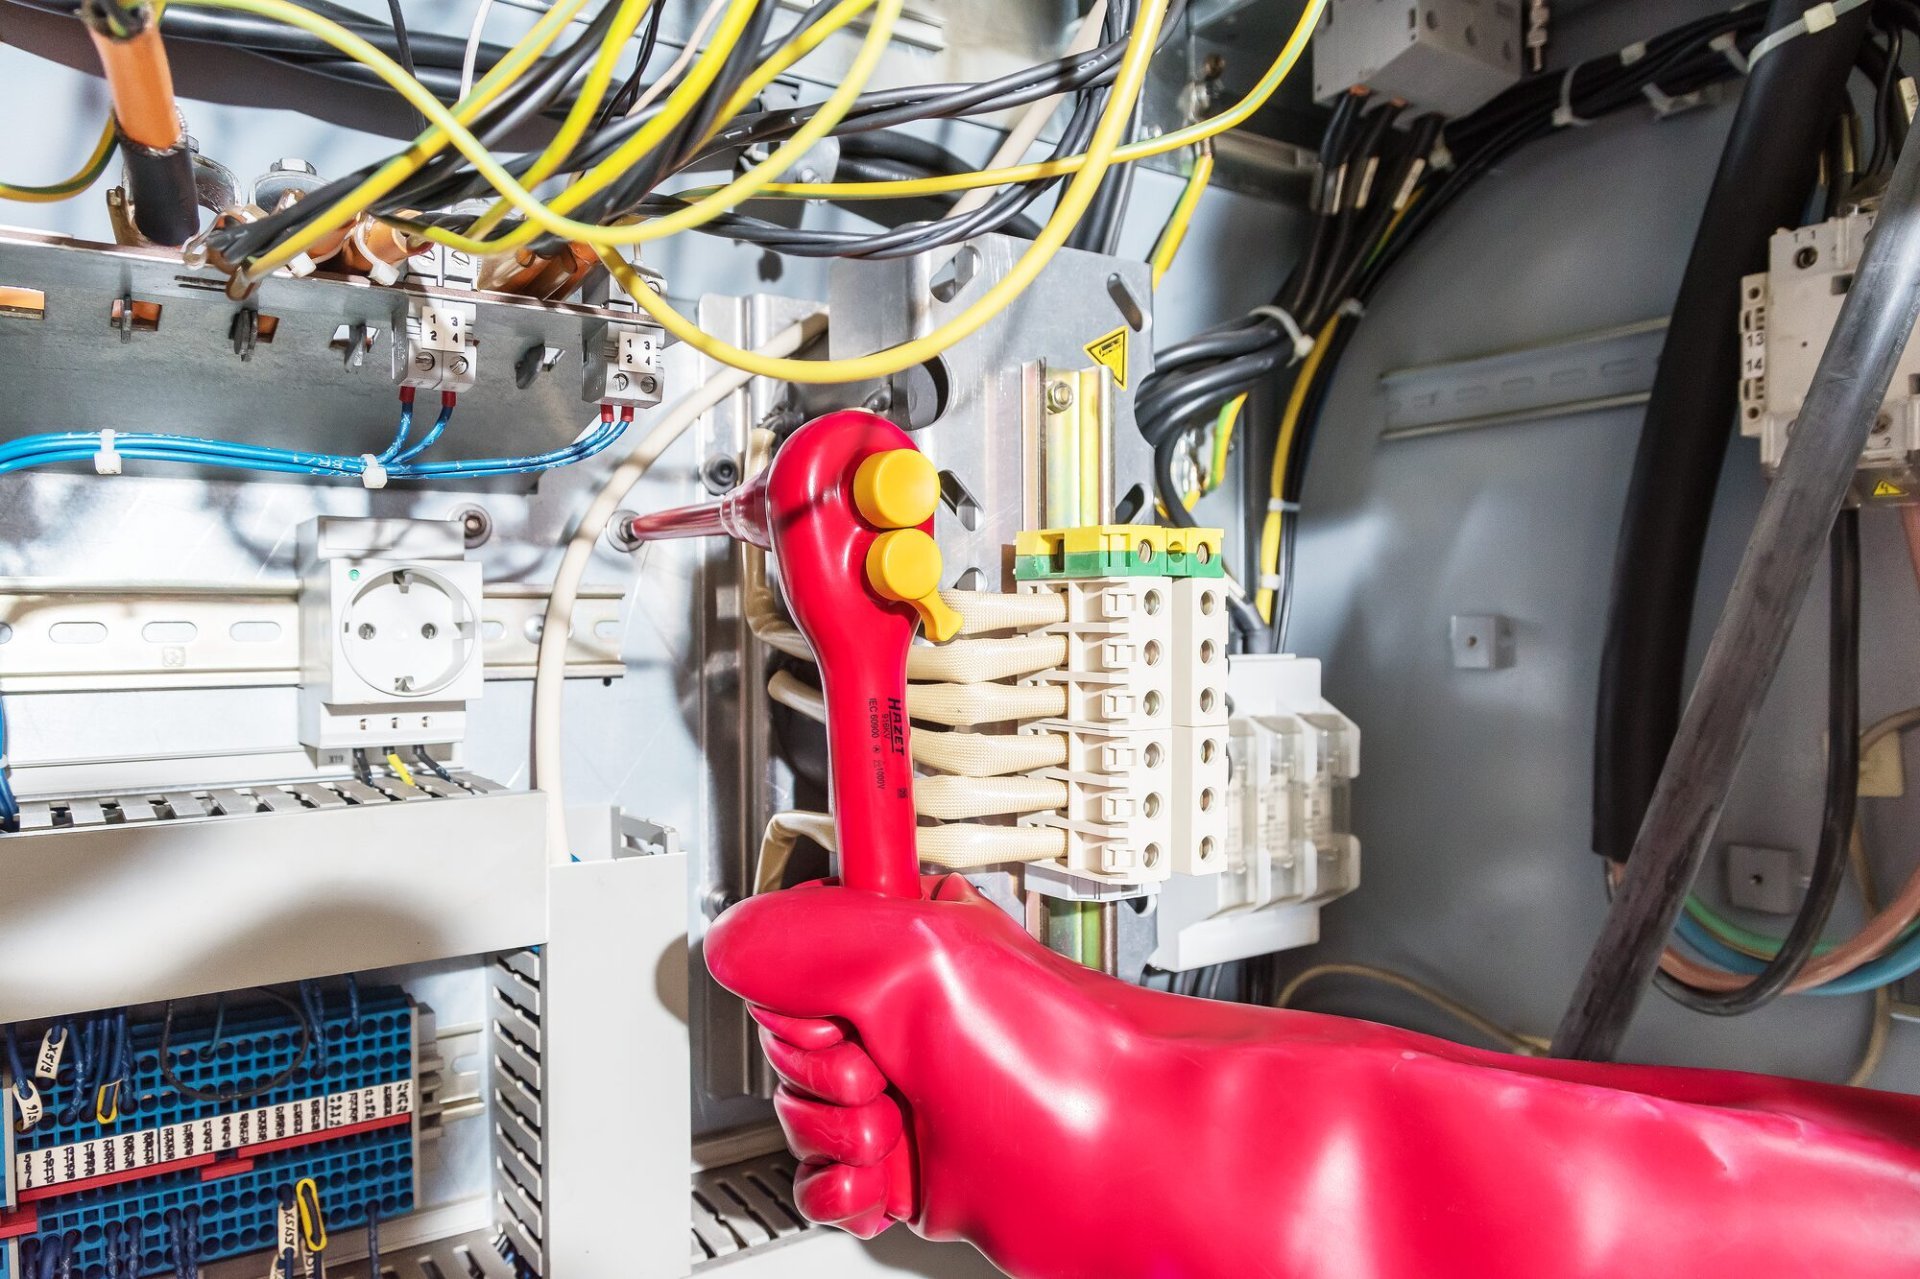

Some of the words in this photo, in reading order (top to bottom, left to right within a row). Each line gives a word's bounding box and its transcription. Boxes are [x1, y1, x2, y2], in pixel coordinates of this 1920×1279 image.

[430, 314, 436, 324] 1
[451, 316, 458, 326] 3
[430, 330, 437, 341] 2
[452, 333, 459, 343] 4
[1747, 333, 1765, 347] 13
[644, 341, 651, 350] 3
[626, 354, 633, 363] 2
[645, 356, 651, 366] 4
[1746, 358, 1763, 371] 14
[869, 698, 878, 712] IEC
[870, 714, 879, 738] 60900
[888, 697, 905, 756] HAZET
